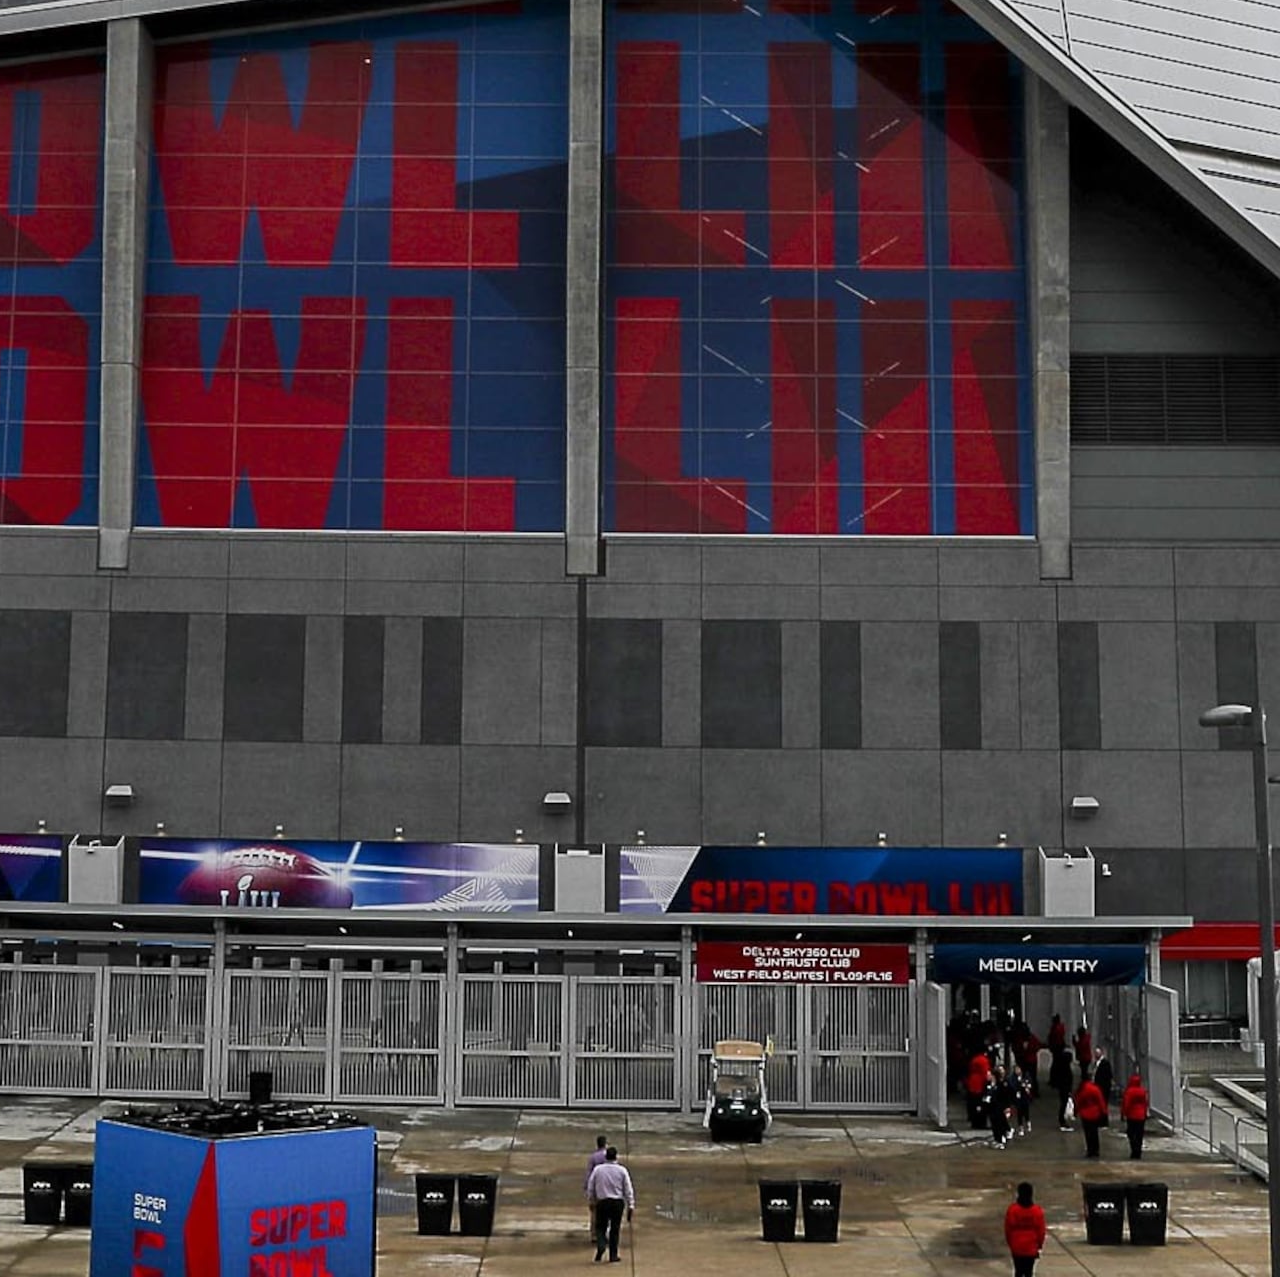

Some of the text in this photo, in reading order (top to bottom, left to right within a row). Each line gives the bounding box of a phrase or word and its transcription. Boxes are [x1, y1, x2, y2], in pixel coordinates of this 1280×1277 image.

[614, 297, 1020, 536] LIII
[690, 879, 816, 914] SUPER
[829, 881, 938, 914] BOWL
[742, 946, 861, 958] DELTA SKY360 CLUB
[754, 957, 851, 968] SUNTRUST CLUB
[978, 958, 1099, 973] MEDIA ENTRY
[712, 969, 747, 980] WEST
[747, 970, 781, 980] FIELD
[782, 970, 824, 981] SUITES
[133, 1193, 167, 1212] SUPER
[133, 1207, 162, 1224] BOWL
[249, 1199, 347, 1247] SUPER
[249, 1244, 334, 1277] BOWL
